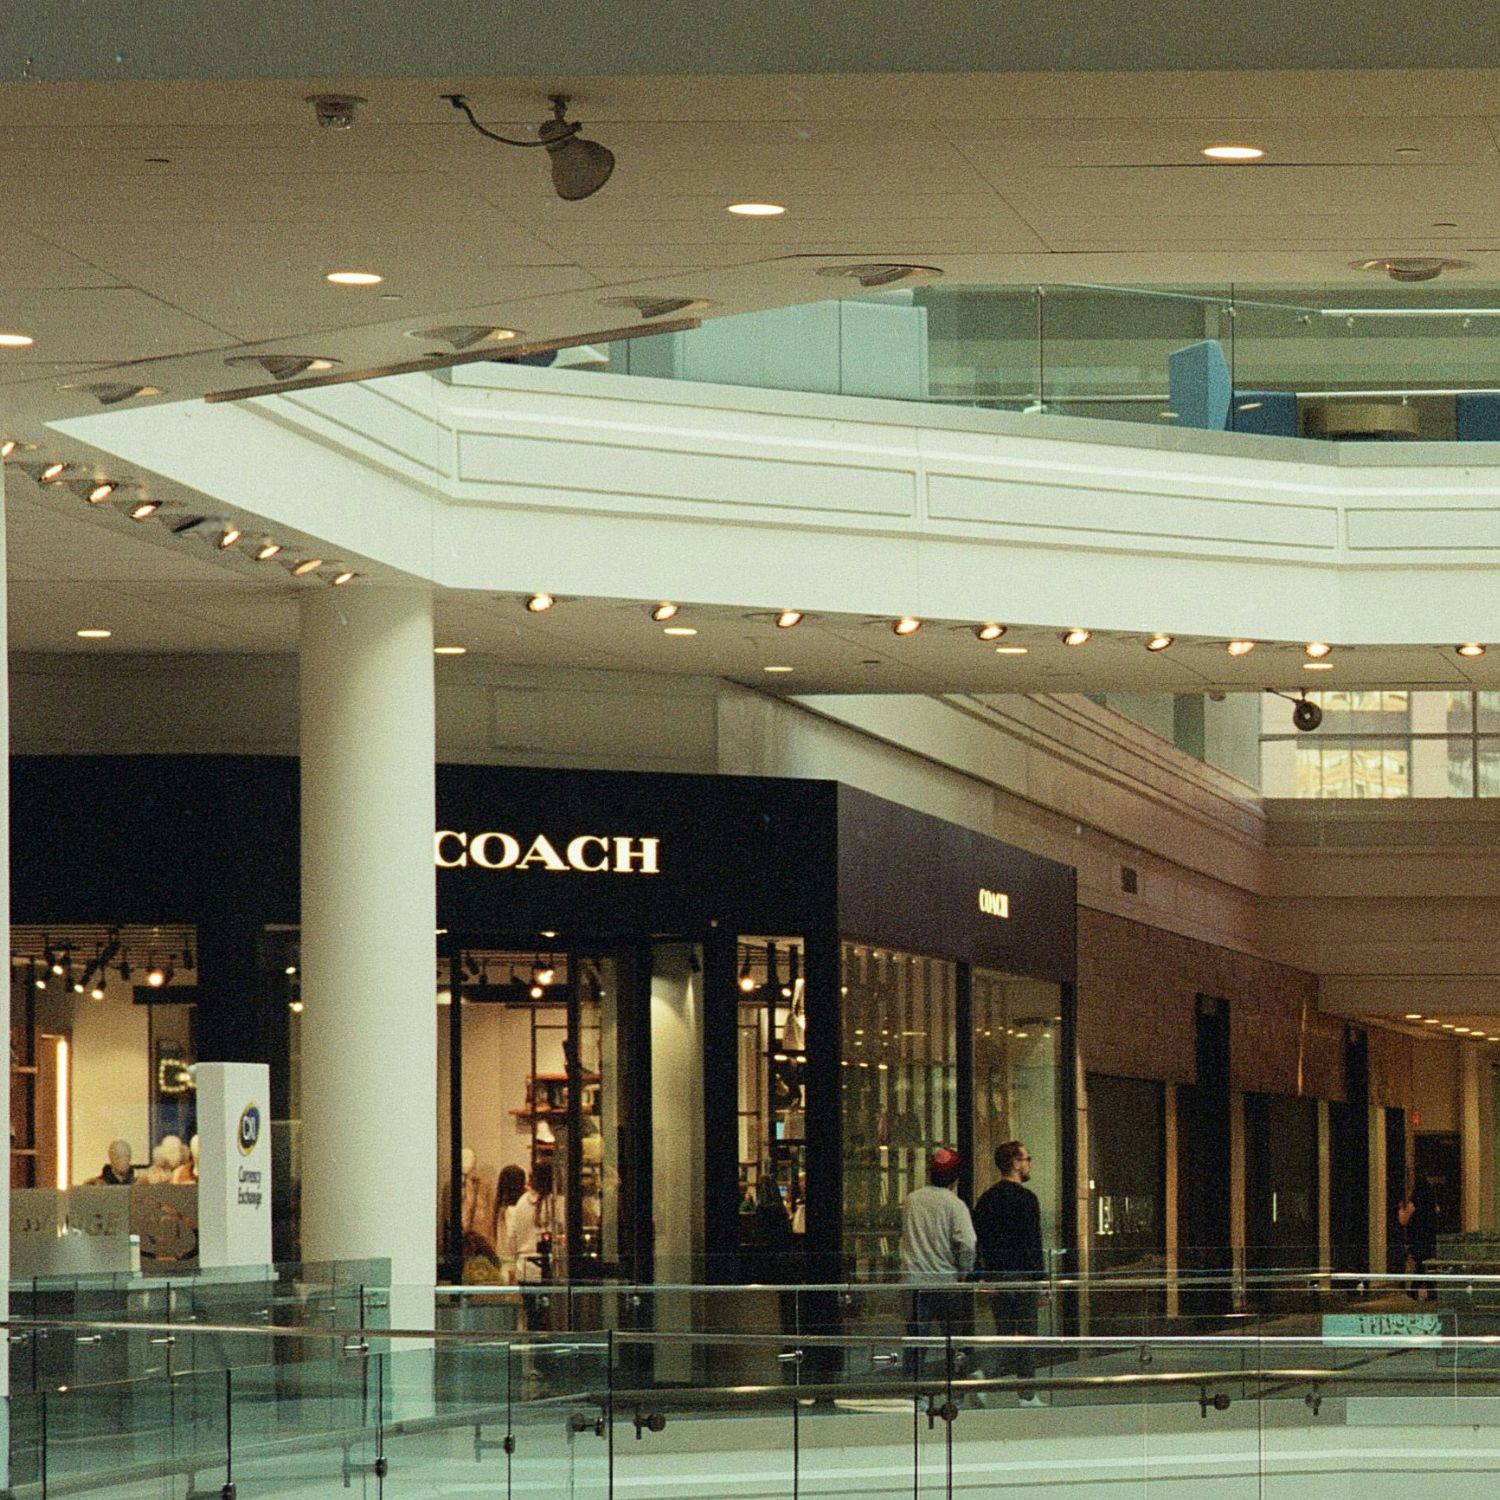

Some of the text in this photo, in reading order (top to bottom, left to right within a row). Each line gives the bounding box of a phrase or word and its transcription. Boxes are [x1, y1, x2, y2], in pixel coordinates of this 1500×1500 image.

[434, 830, 661, 873] COACH
[979, 888, 1009, 918] COACH
[239, 1164, 262, 1189] Currency
[237, 1186, 263, 1210] Exchange
